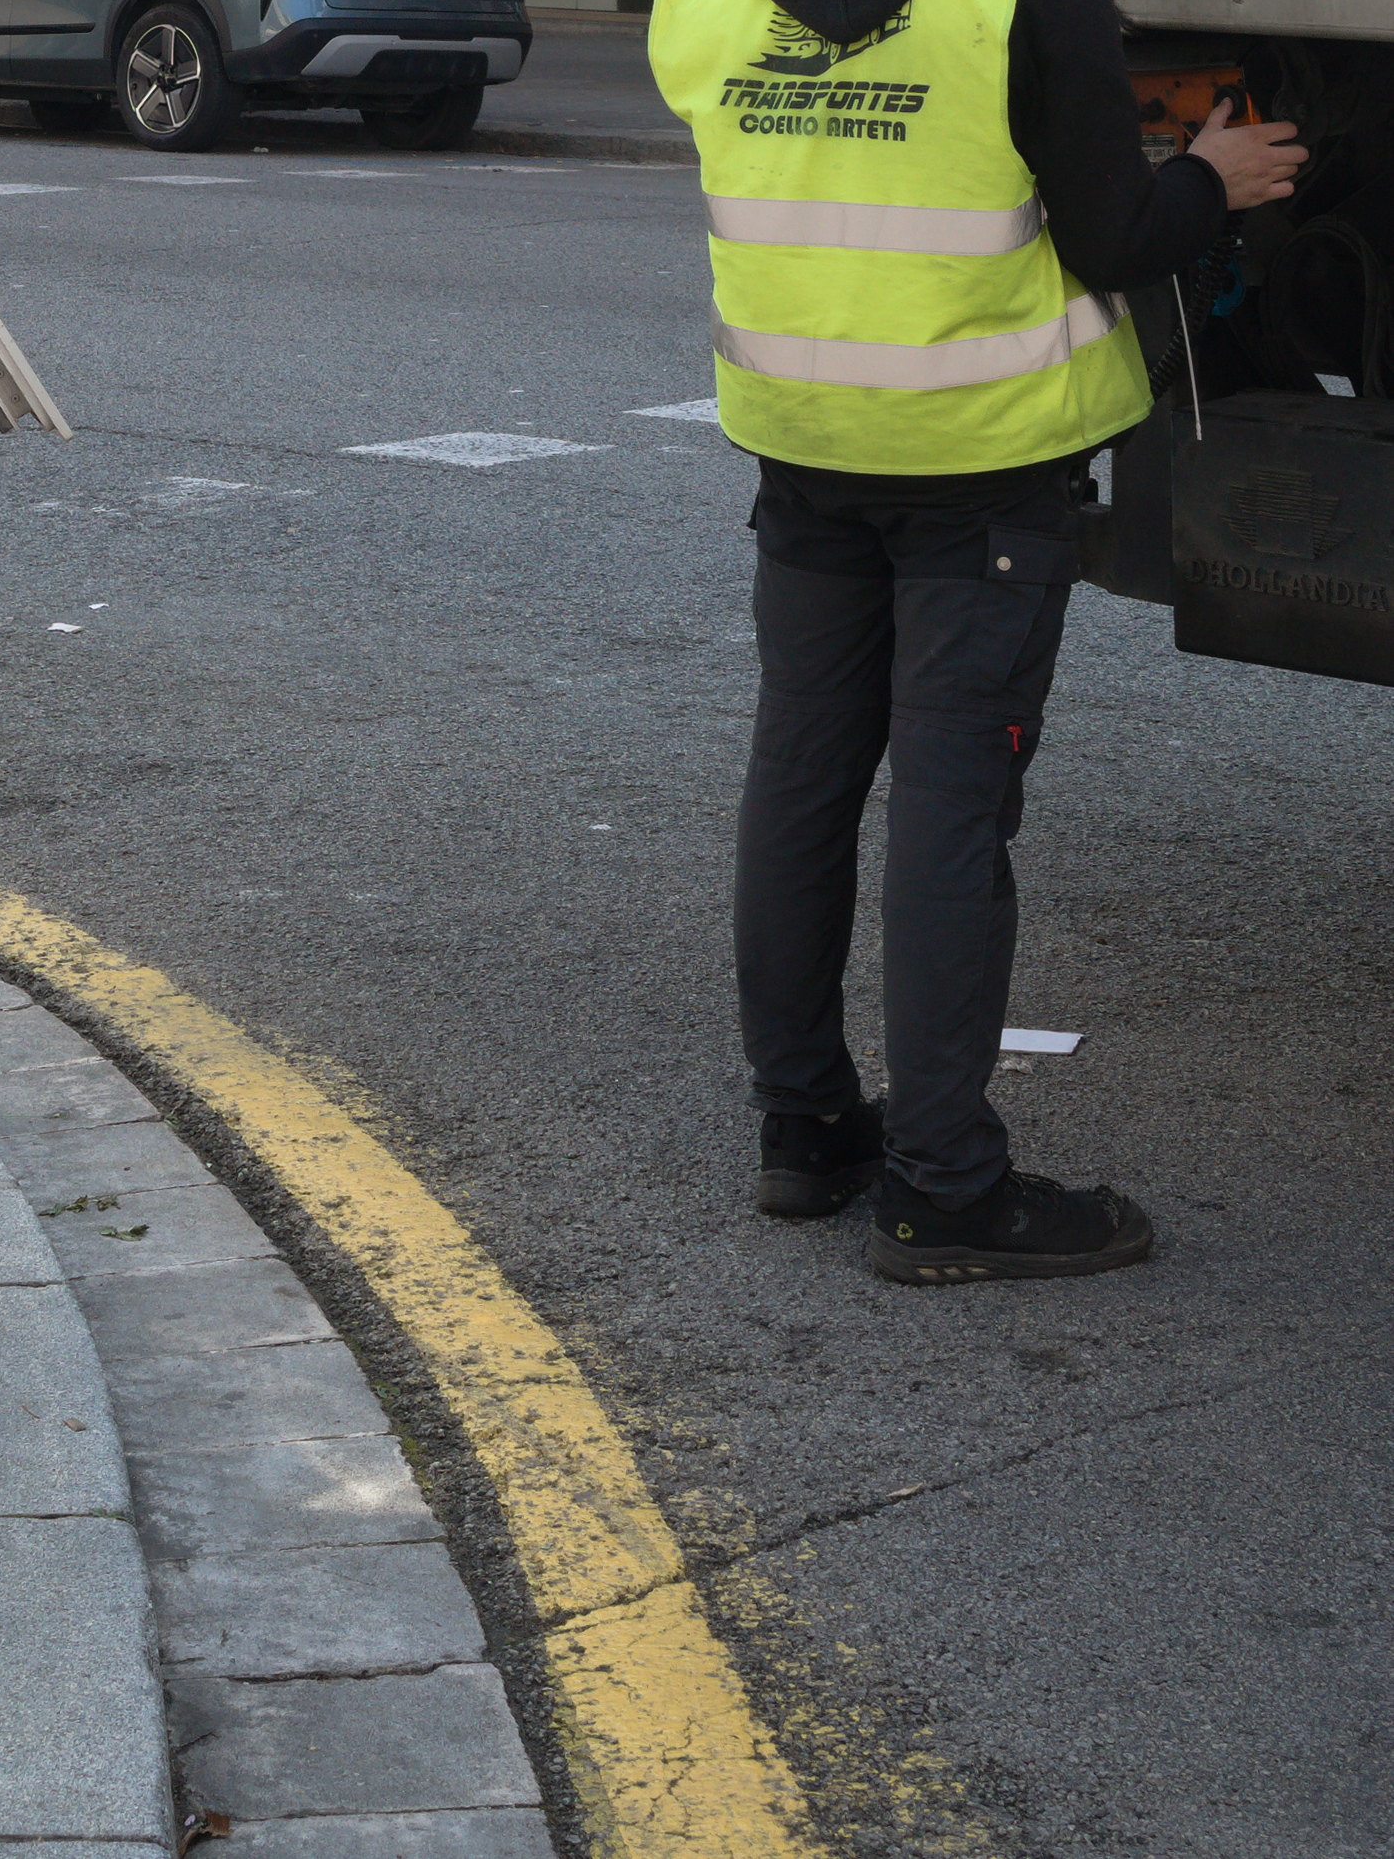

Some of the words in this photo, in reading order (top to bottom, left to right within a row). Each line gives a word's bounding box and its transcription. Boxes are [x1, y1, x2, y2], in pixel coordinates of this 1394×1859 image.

[720, 77, 931, 113] TRANSPORTES
[739, 113, 819, 136] COELLO
[826, 116, 907, 142] ARTETA
[1183, 557, 1391, 612] DHOLLANDIA
